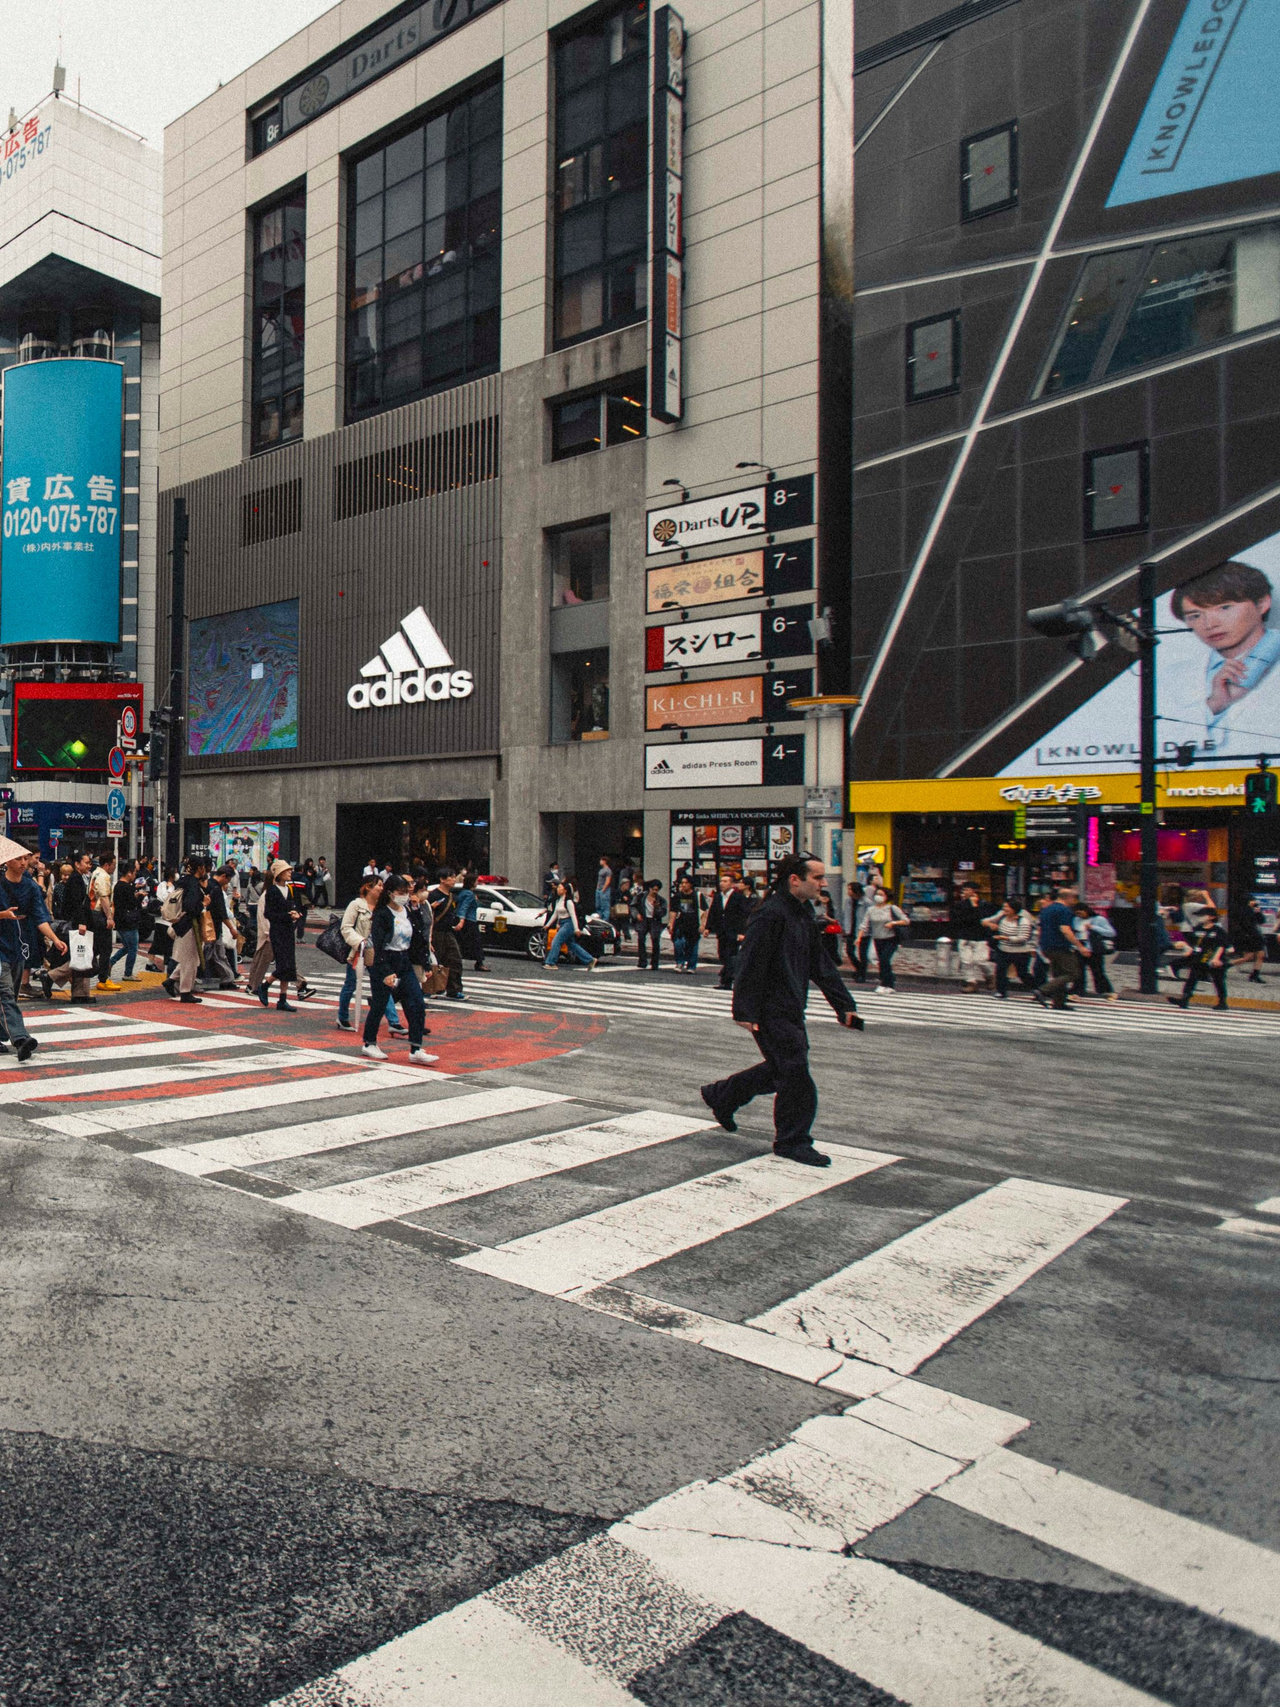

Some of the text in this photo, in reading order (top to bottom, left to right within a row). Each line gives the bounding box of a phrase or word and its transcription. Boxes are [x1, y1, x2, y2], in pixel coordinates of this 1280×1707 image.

[351, 24, 418, 80] Darts
[266, 124, 280, 143] 8F
[6, 473, 116, 506] 貸広告
[678, 501, 761, 534] Darts UP
[666, 631, 756, 657] スシロー
[346, 667, 474, 710] adidas
[125, 714, 134, 730] 30
[1048, 739, 1217, 758] KNOWLDGE
[650, 767, 674, 775] adidas
[682, 759, 758, 770] adidas Press Room
[111, 796, 119, 816] P
[740, 811, 785, 819] DOGENZAKA
